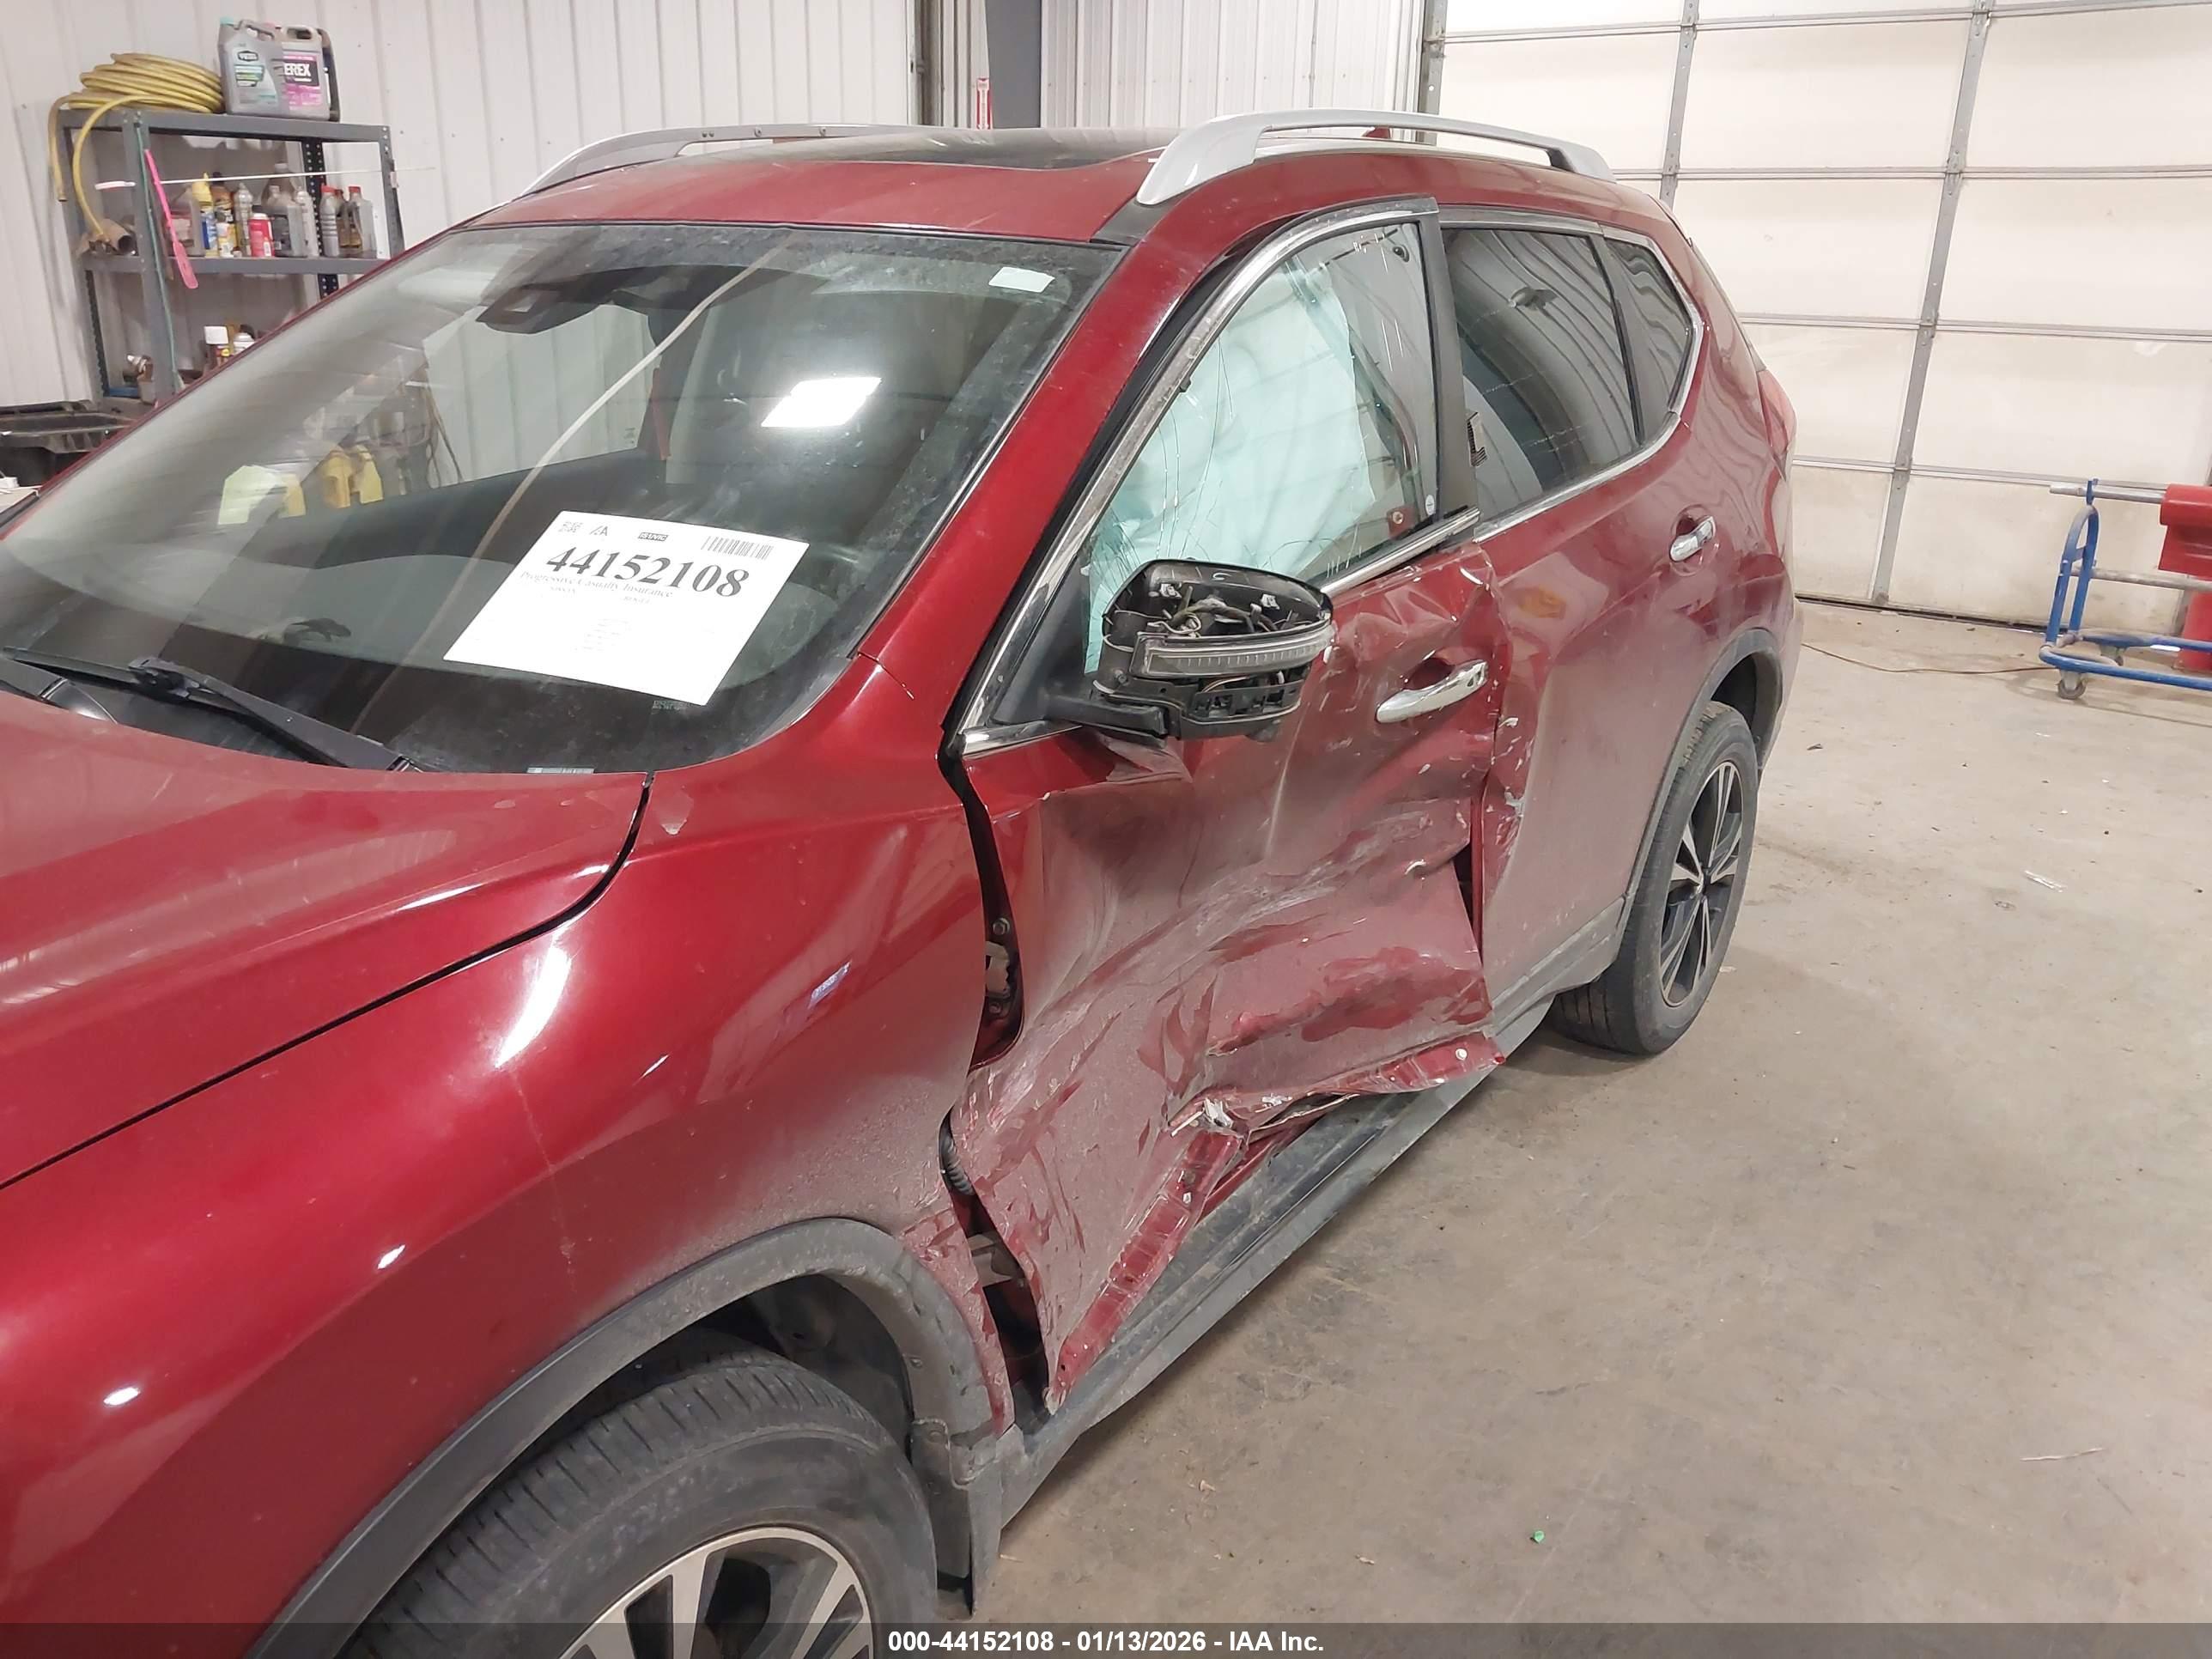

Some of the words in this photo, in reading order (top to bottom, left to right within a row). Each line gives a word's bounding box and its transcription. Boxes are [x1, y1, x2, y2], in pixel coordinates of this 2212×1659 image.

[520, 571, 574, 585] Progressive
[623, 583, 673, 597] Insurance
[546, 546, 750, 597] 44152108
